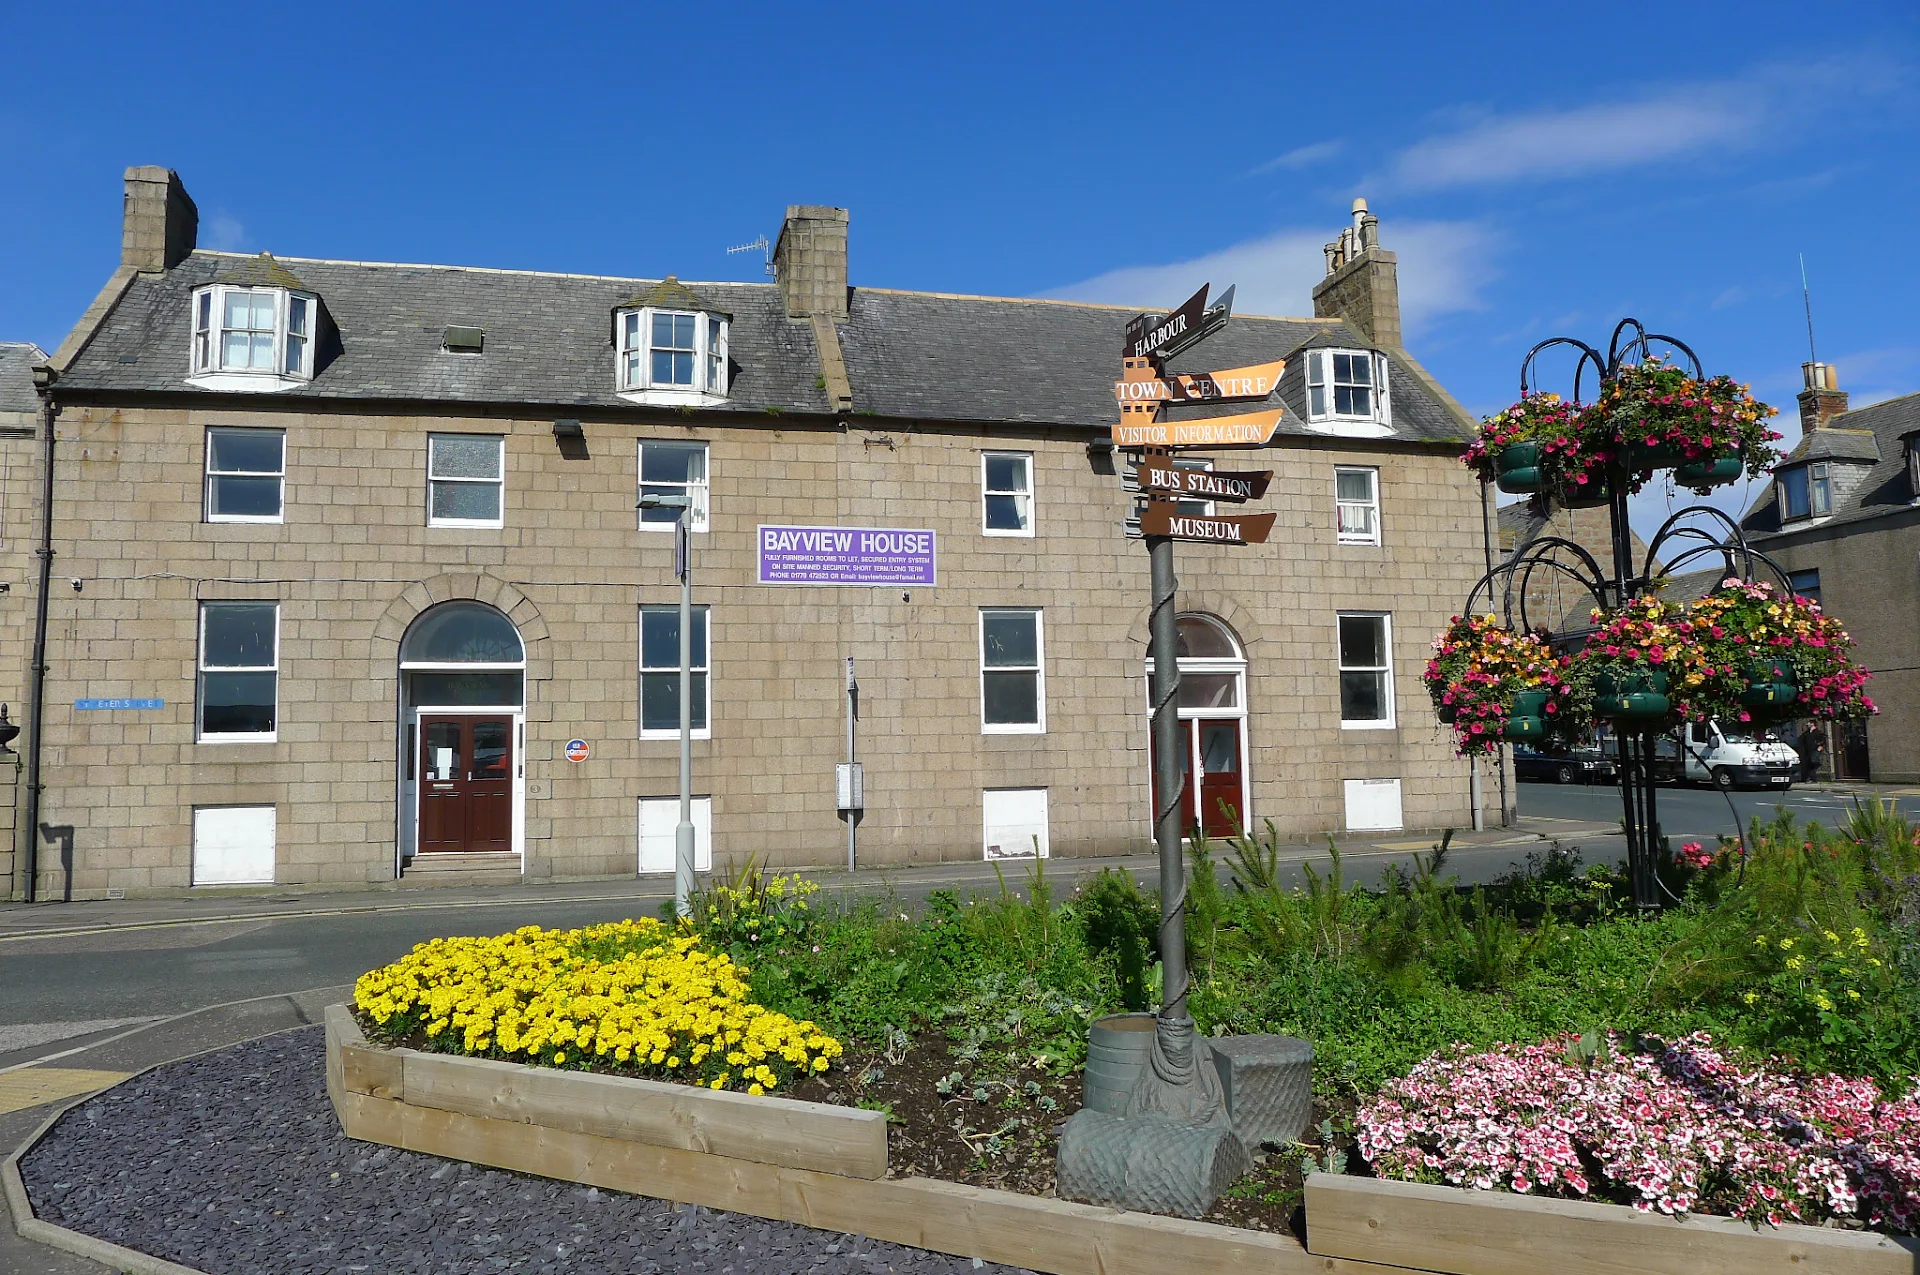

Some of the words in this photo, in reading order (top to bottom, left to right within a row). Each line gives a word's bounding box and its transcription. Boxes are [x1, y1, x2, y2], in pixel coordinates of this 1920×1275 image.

[1134, 313, 1188, 357] HARBOUR
[1116, 380, 1175, 400] TOWN
[1185, 377, 1269, 398] CENTRE
[1118, 426, 1168, 443] VISITOR
[1175, 424, 1262, 442] INFORMATION
[1150, 468, 1180, 489] BUS
[1188, 473, 1252, 497] STATION
[1169, 517, 1241, 540] MUSEUM
[764, 531, 853, 552] BAYVIEW
[861, 533, 930, 554] HOUSE
[782, 554, 815, 562] FURNISHED
